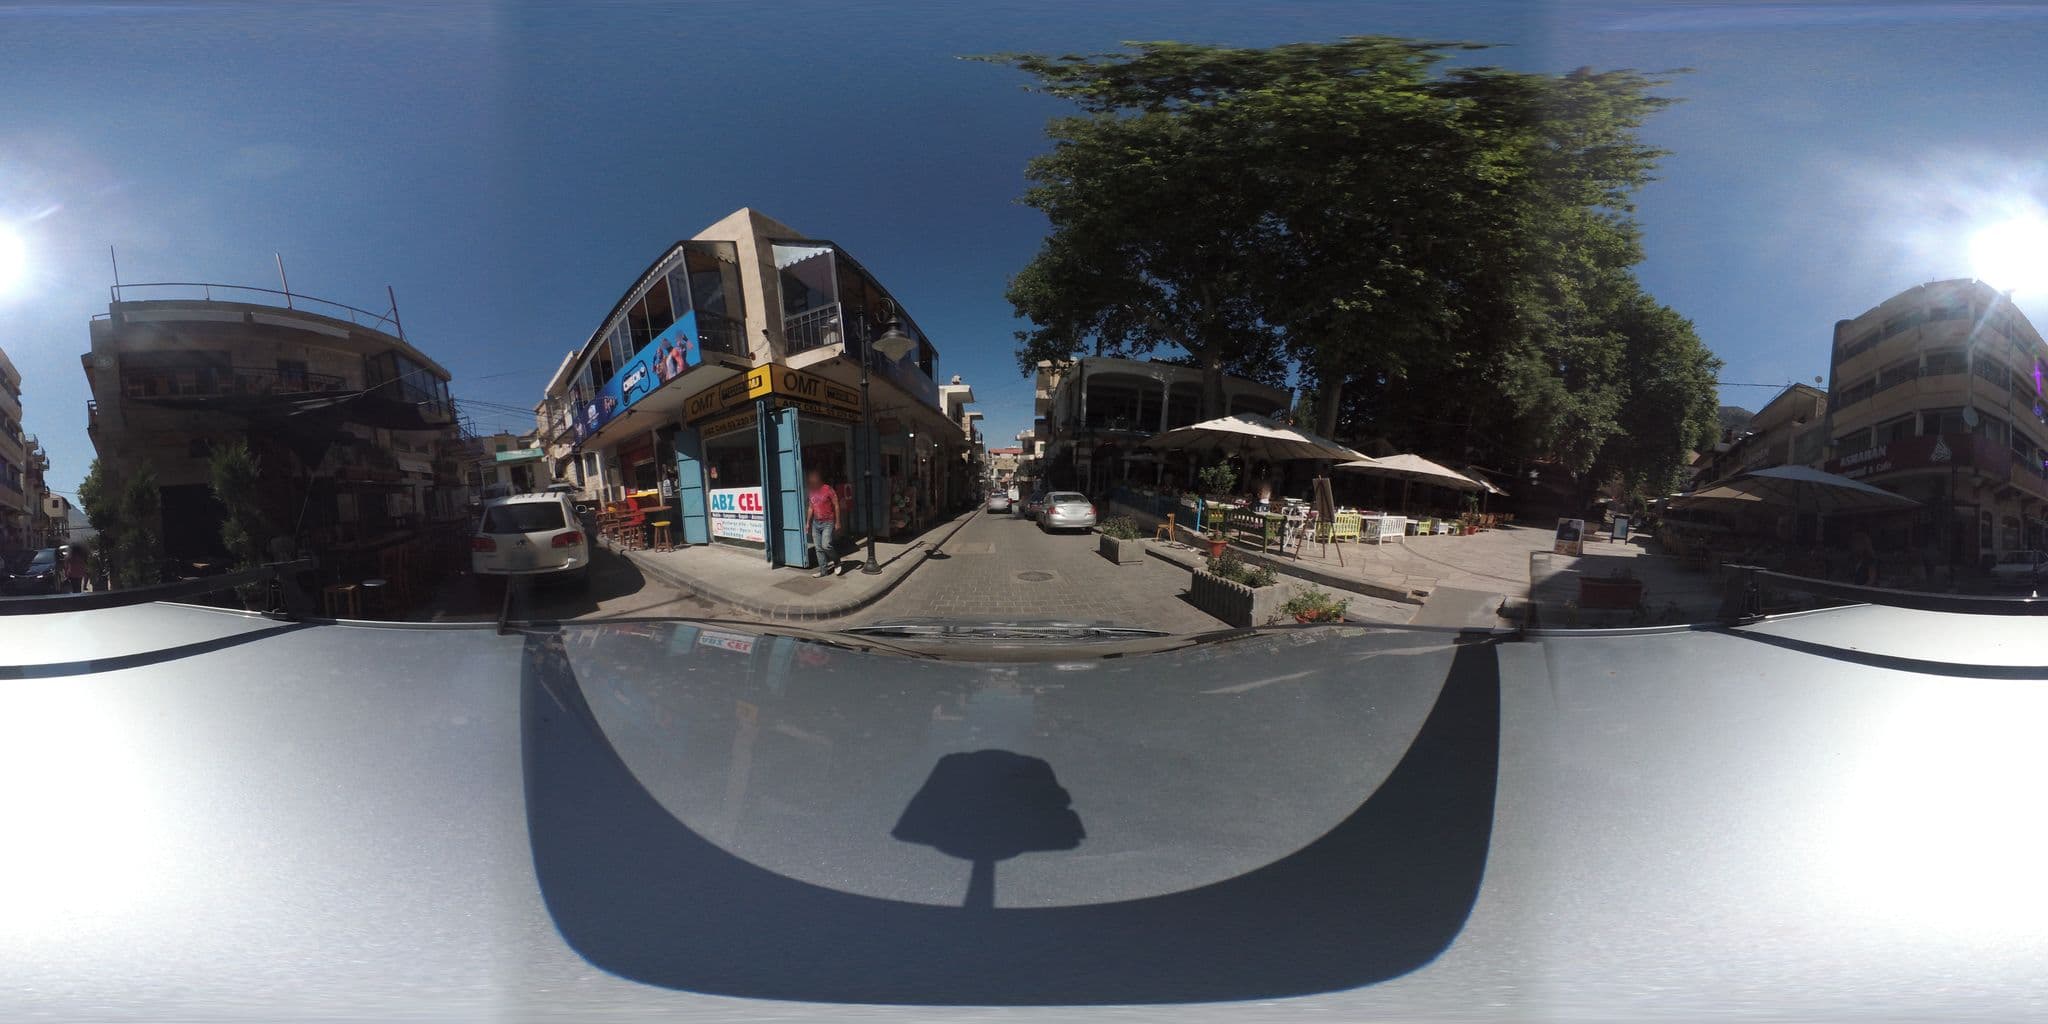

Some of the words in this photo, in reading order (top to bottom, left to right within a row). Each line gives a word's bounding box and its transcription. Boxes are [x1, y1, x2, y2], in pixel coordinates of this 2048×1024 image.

[784, 371, 820, 397] OMT
[691, 391, 716, 415] OMT
[712, 493, 735, 511] ABZ
[738, 492, 763, 511] CEL
